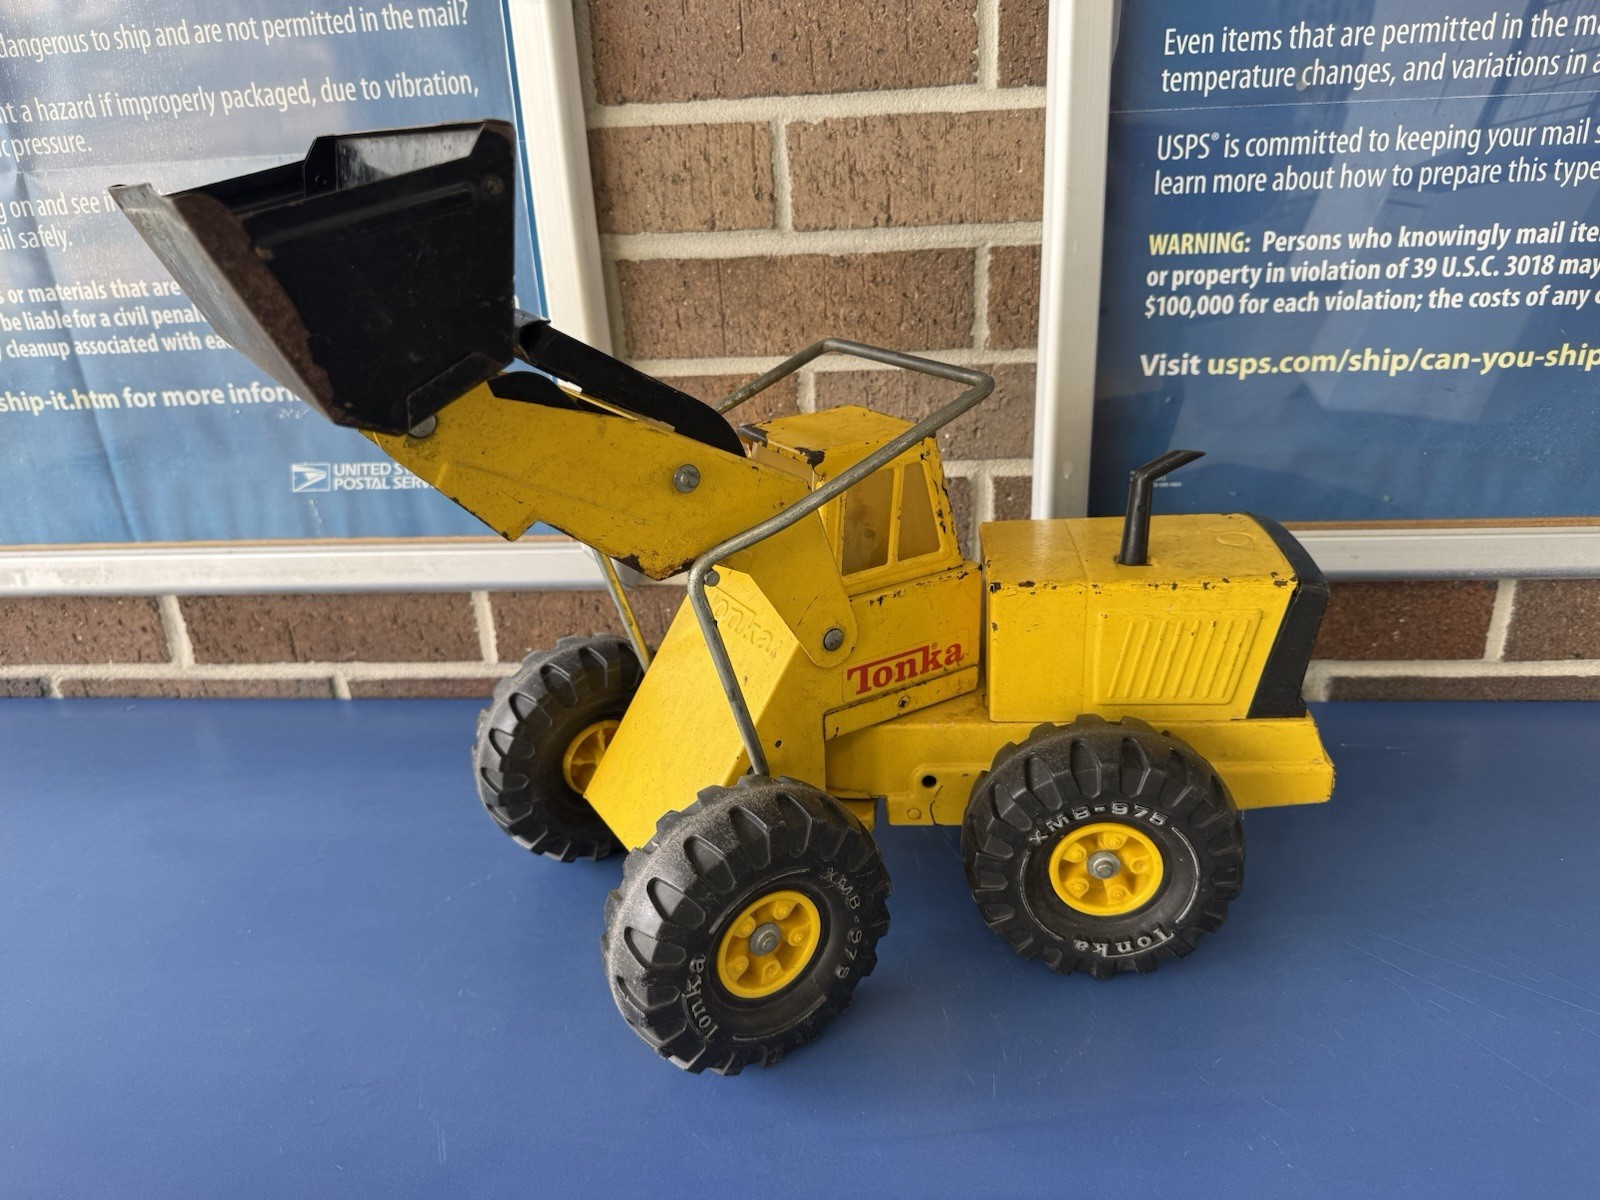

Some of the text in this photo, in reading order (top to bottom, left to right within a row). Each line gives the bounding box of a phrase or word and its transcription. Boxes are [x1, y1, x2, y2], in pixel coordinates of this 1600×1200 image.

[90, 30, 110, 51] to
[114, 24, 151, 54] ship
[155, 19, 190, 46] and
[193, 24, 223, 43] are
[226, 17, 259, 41] not
[262, 6, 356, 45] permitted
[359, 7, 379, 32] in
[381, 3, 414, 30] the
[417, 0, 468, 27] mail?
[1165, 28, 1214, 55] Even
[1222, 26, 1282, 52] items
[1289, 21, 1335, 49] that
[1341, 26, 1375, 47] are
[1381, 12, 1497, 52] permitted
[1502, 13, 1523, 39] in
[1531, 9, 1568, 38] the
[1161, 65, 1295, 97] temperature
[1302, 58, 1396, 90] changes,
[1403, 53, 1446, 81] and
[1453, 51, 1560, 79] variations
[1566, 48, 1587, 74] in
[21, 105, 33, 122] a
[34, 94, 97, 121] hazard
[98, 92, 112, 117] if
[115, 86, 214, 121] improperly
[220, 78, 316, 115] packaged,
[321, 77, 357, 102] due
[360, 78, 381, 100] to
[385, 70, 478, 98] vibration,
[10, 134, 92, 162] pressure.
[1224, 133, 1239, 158] is
[1245, 127, 1363, 157] committed
[1369, 130, 1389, 152] to
[1396, 124, 1481, 156] keeping
[1485, 127, 1536, 154] your
[1541, 118, 1590, 145] mail
[1155, 156, 1600, 195] learn more about how to prepare this type
[10, 200, 34, 218] on
[36, 189, 68, 216] and
[71, 195, 101, 214] see
[19, 224, 73, 252] safely.
[1149, 220, 1600, 255] WARNING: Persons who knowingly mail ite
[1147, 255, 1600, 291] or property in violation of 39 U.S.C. 3018 may
[7, 289, 24, 304] or
[27, 280, 107, 303] materials
[109, 279, 150, 298] that
[152, 280, 182, 296] are
[1145, 295, 1234, 318] $100,000
[1239, 293, 1269, 314] for
[1273, 291, 1319, 313] each
[1325, 289, 1423, 312] violation;
[1429, 287, 1463, 308] the
[1469, 288, 1521, 308] costs
[1526, 285, 1551, 306] of
[1552, 289, 1591, 310] any
[0, 313, 22, 331] be
[22, 310, 72, 330] liable
[72, 309, 96, 328] for
[100, 313, 111, 327] a
[113, 305, 149, 326] civil
[6, 339, 70, 361] cleanup
[74, 333, 159, 355] associated
[161, 331, 202, 351] with
[1140, 353, 1201, 376] Visit
[123, 387, 156, 408] for
[162, 389, 225, 407] more
[333, 461, 393, 477] UNITED
[333, 475, 392, 491] POSTAL
[1028, 801, 1170, 846] XMB-975
[1072, 922, 1176, 958] Tonka
